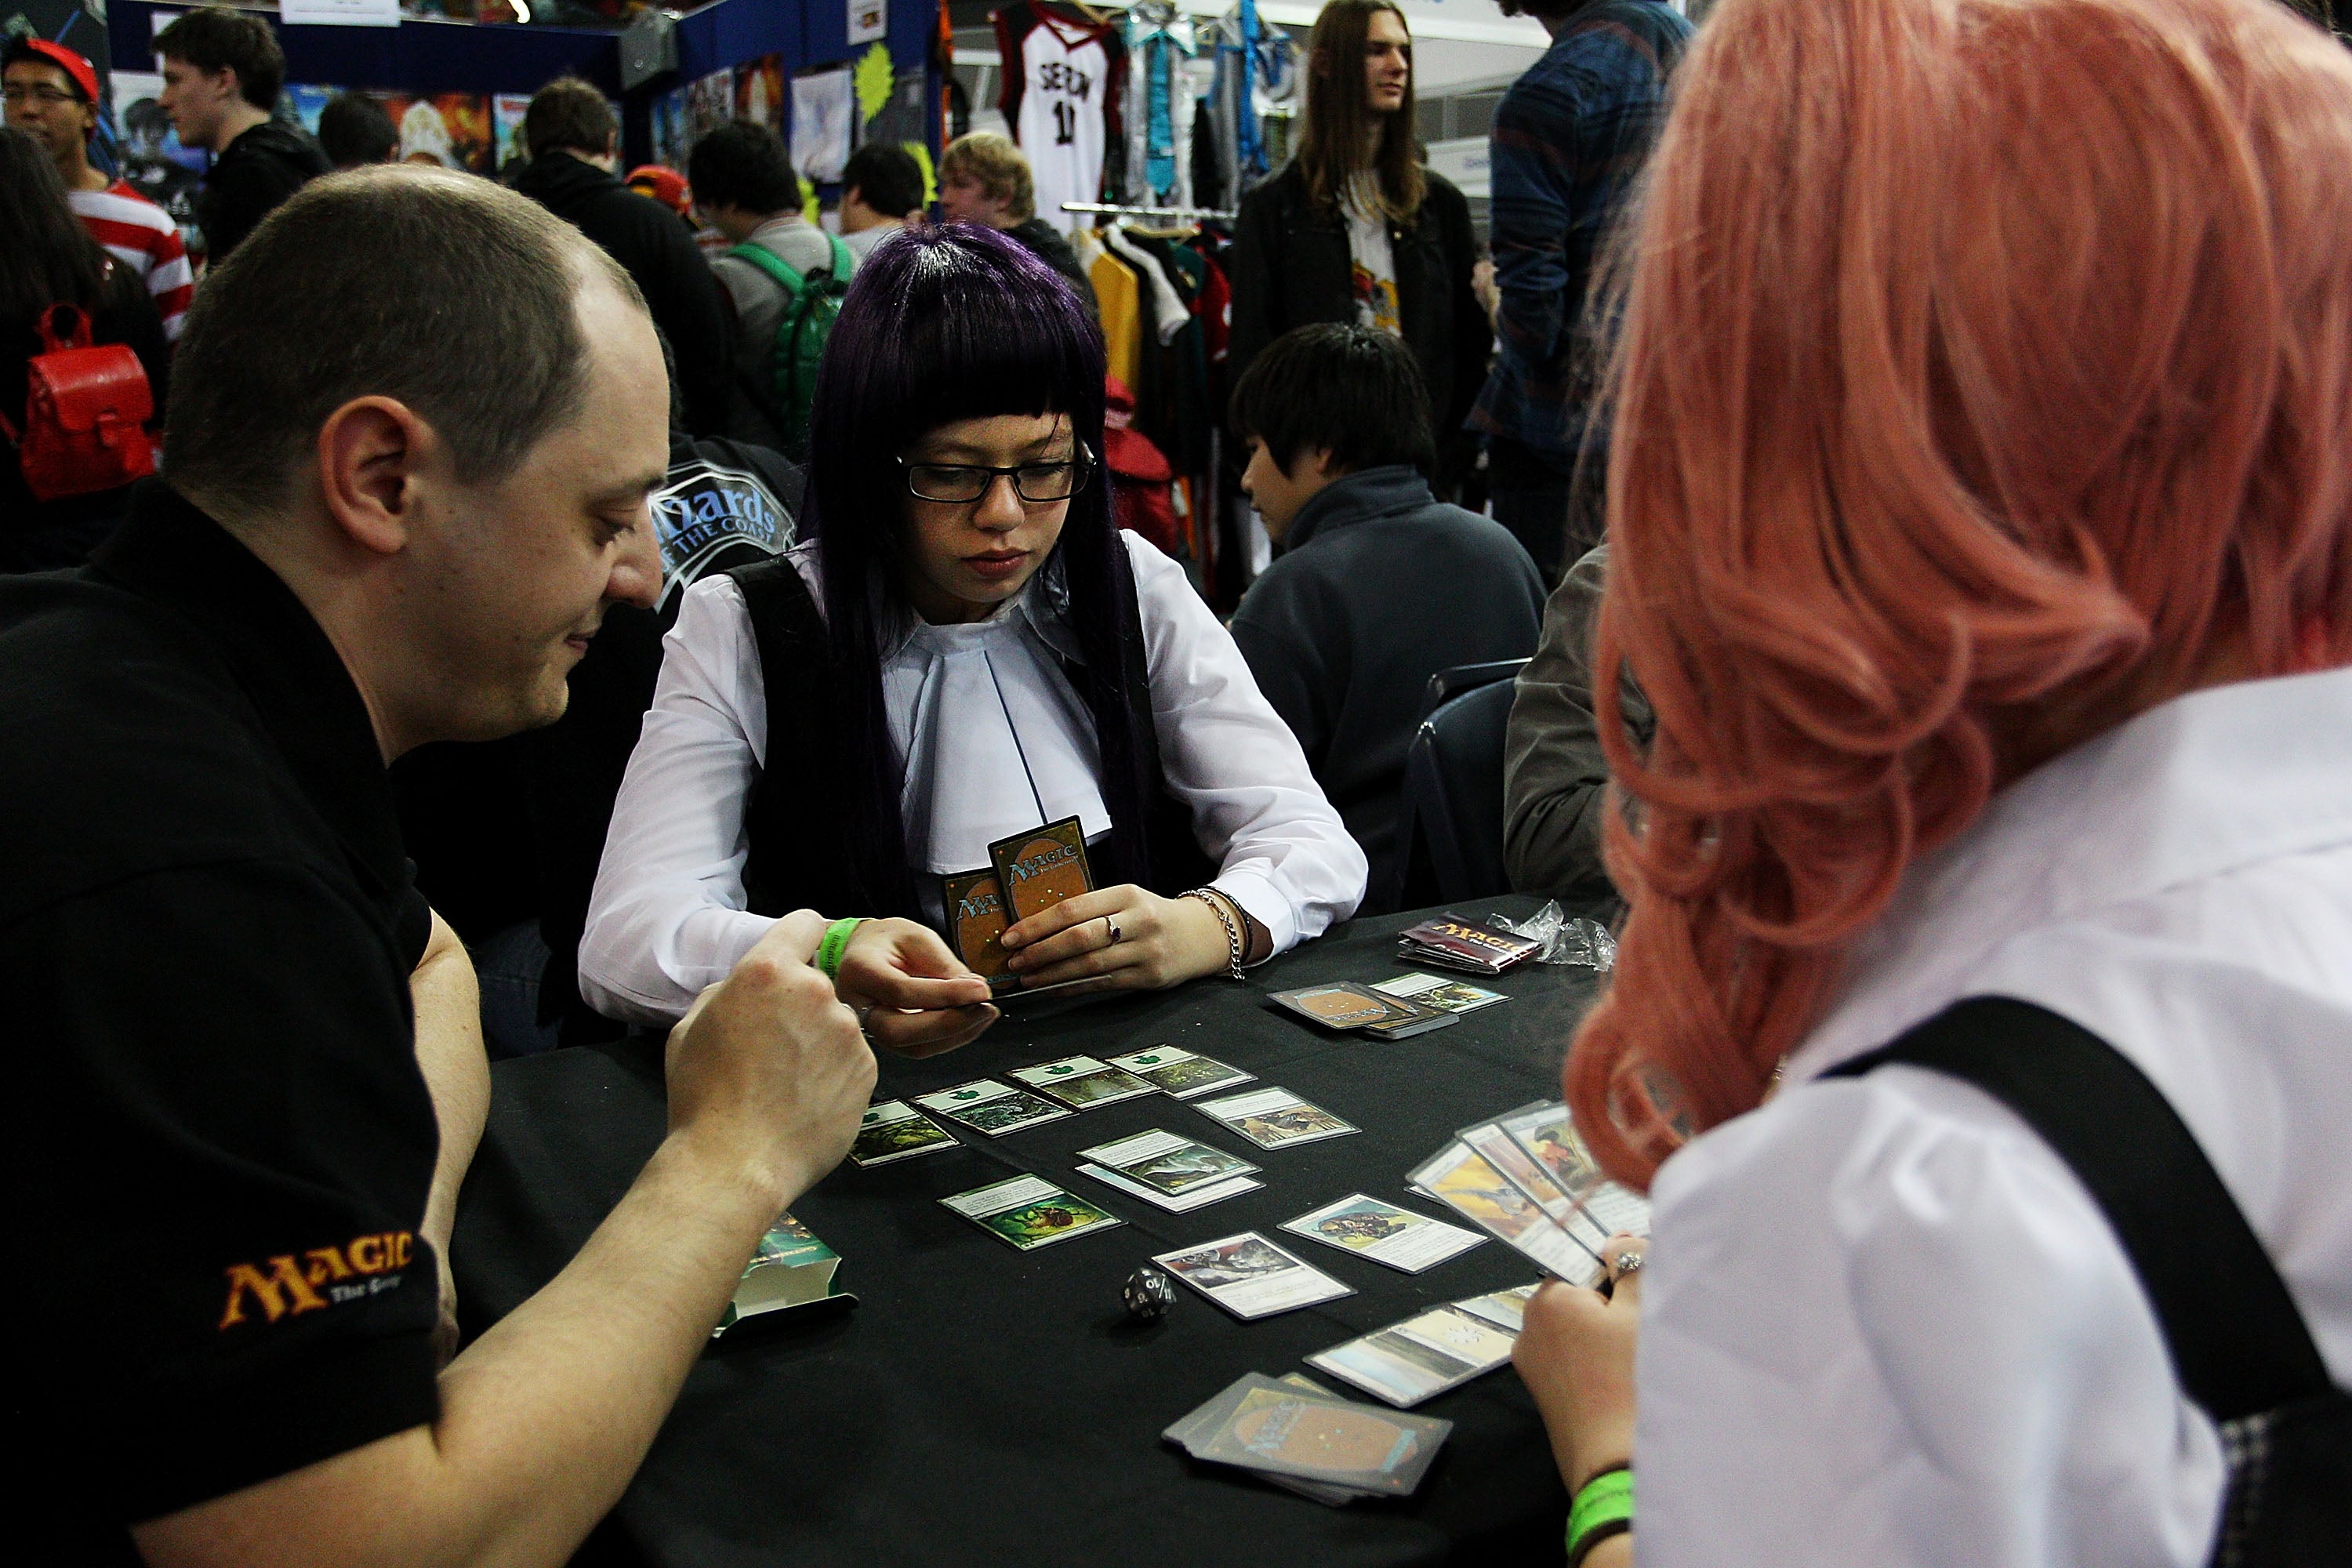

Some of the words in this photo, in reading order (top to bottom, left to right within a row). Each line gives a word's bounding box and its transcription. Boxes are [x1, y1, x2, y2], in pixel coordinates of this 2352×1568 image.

[652, 487, 775, 543] izards
[672, 521, 718, 554] THE
[721, 517, 771, 543] COAST
[1008, 844, 1078, 887] MAGIC
[1431, 923, 1524, 952] MAGIC
[218, 1230, 412, 1330] MAGIC
